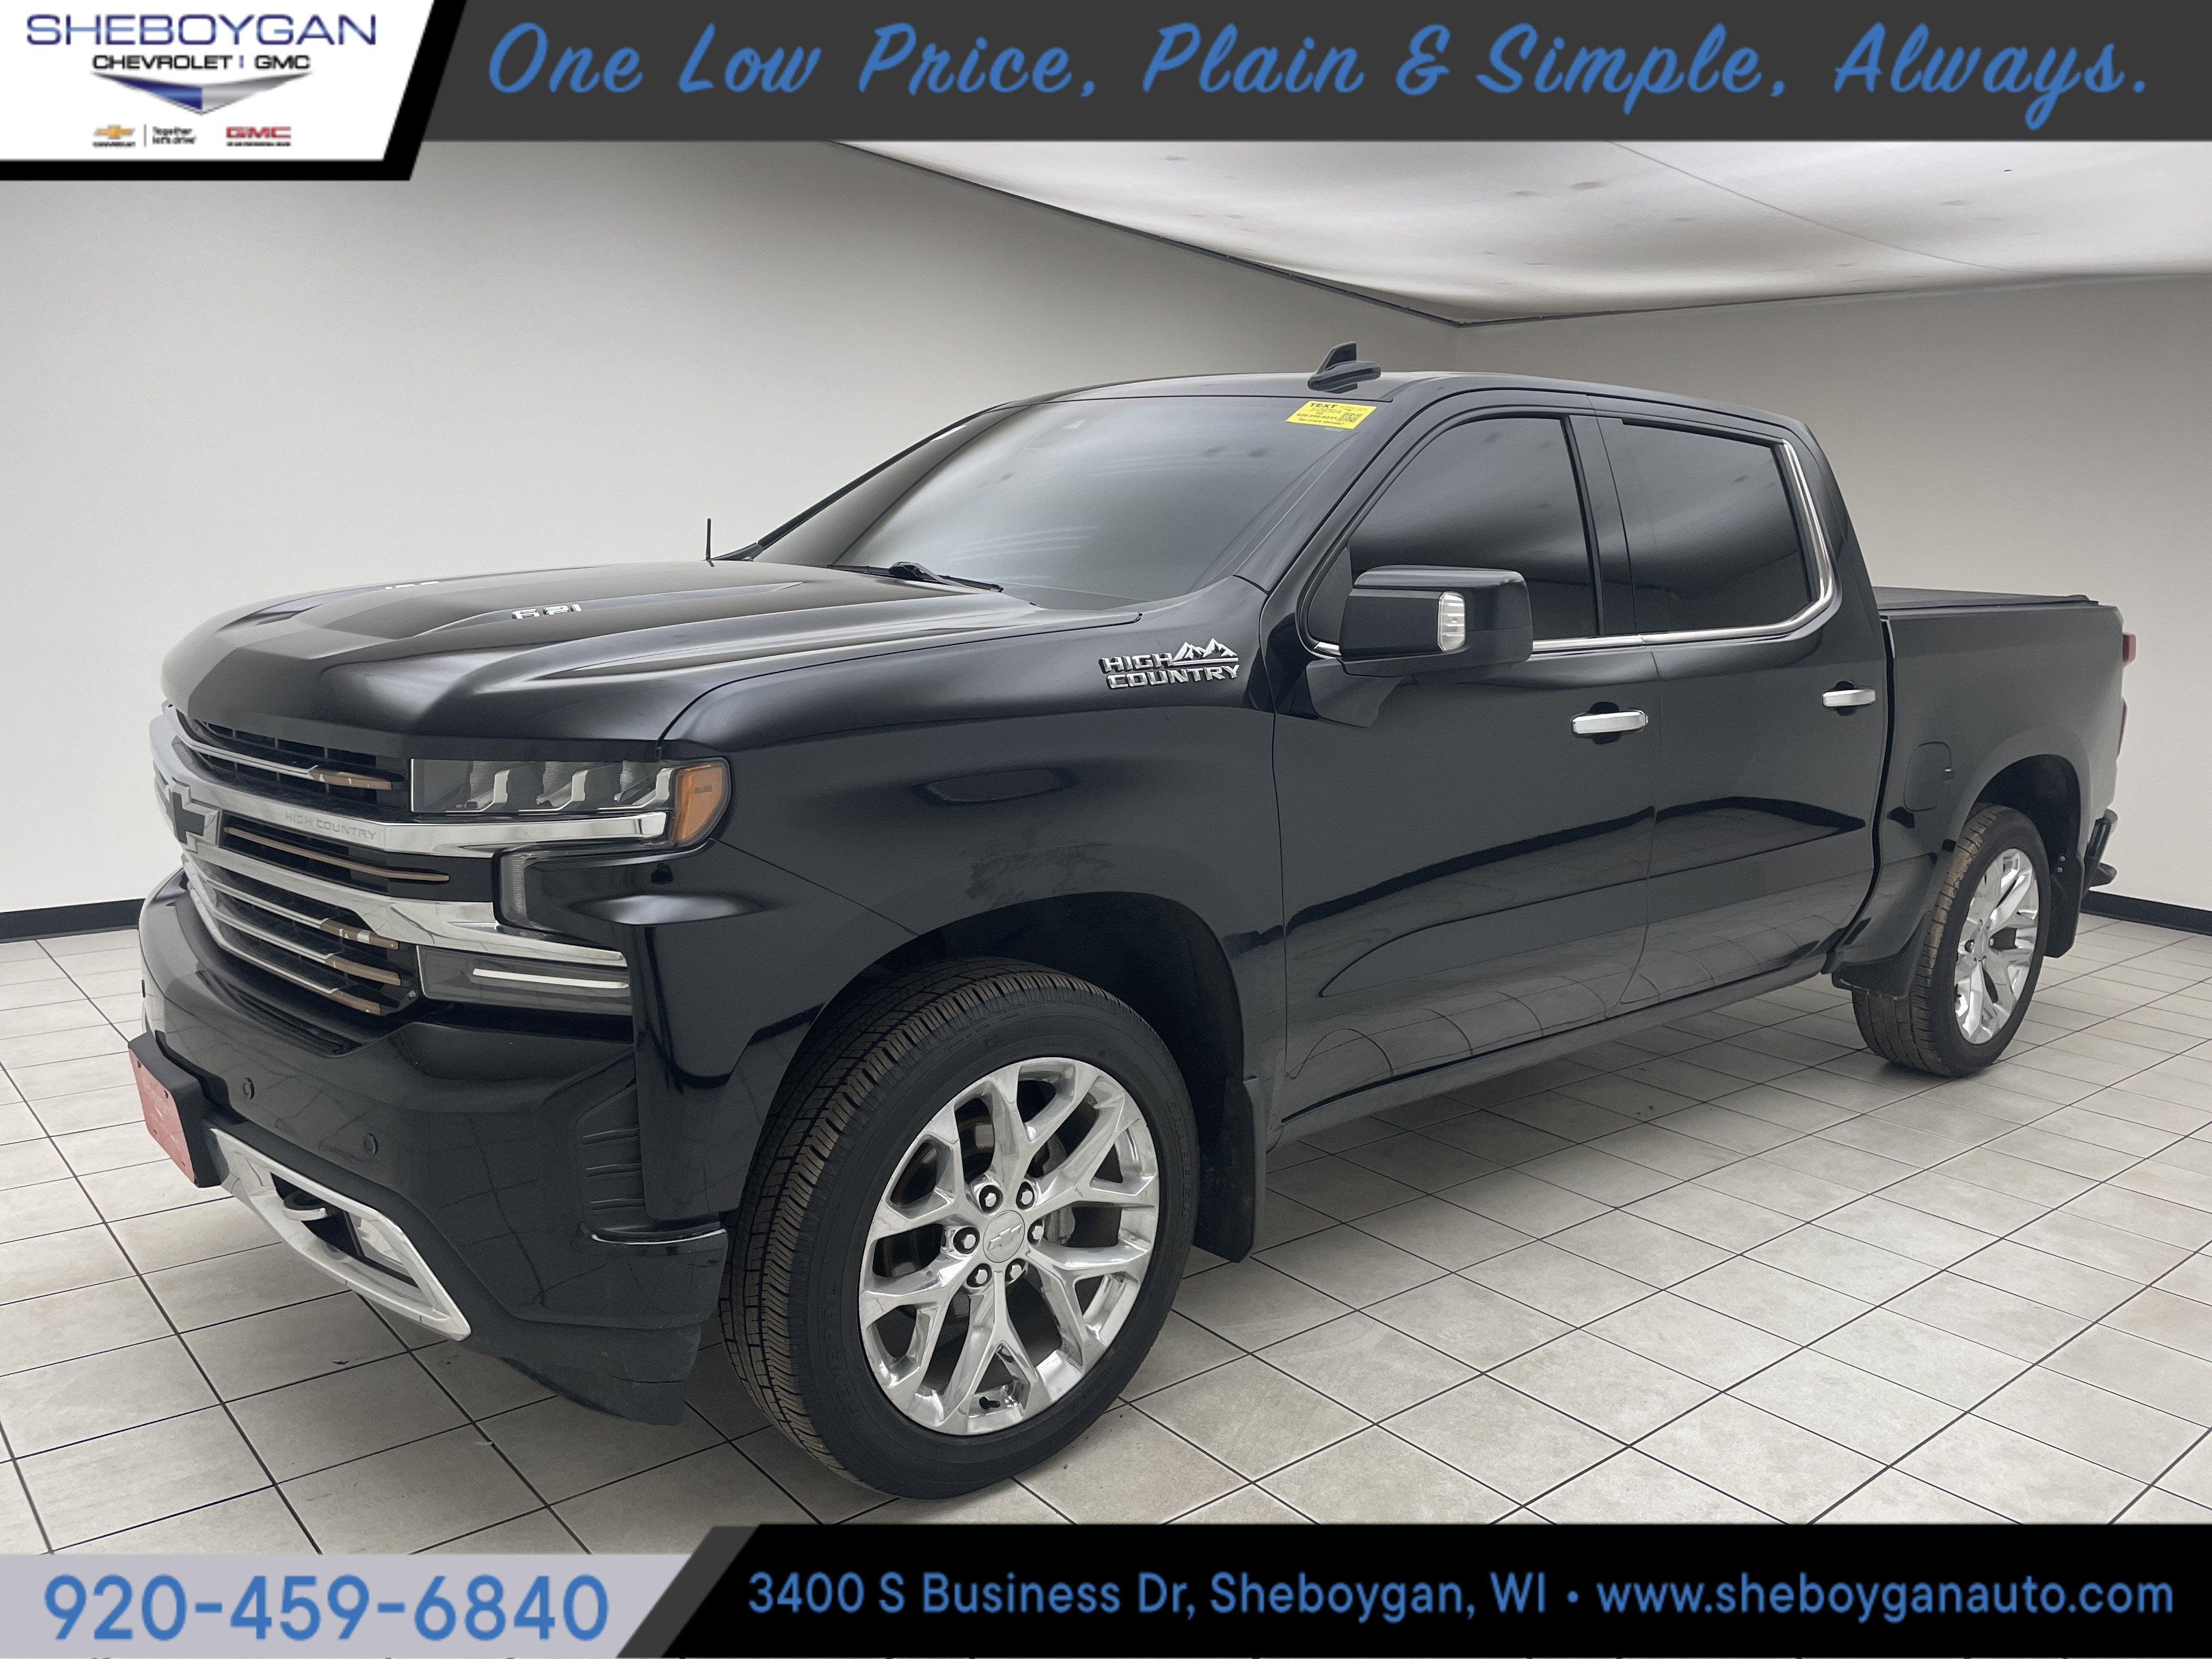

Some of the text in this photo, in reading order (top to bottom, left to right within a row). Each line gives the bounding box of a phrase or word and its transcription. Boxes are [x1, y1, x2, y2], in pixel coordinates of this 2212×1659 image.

[1099, 652, 1175, 674] HIGH
[1105, 664, 1240, 690] COUNTRY
[285, 811, 377, 840] HIGH COUNTRY
